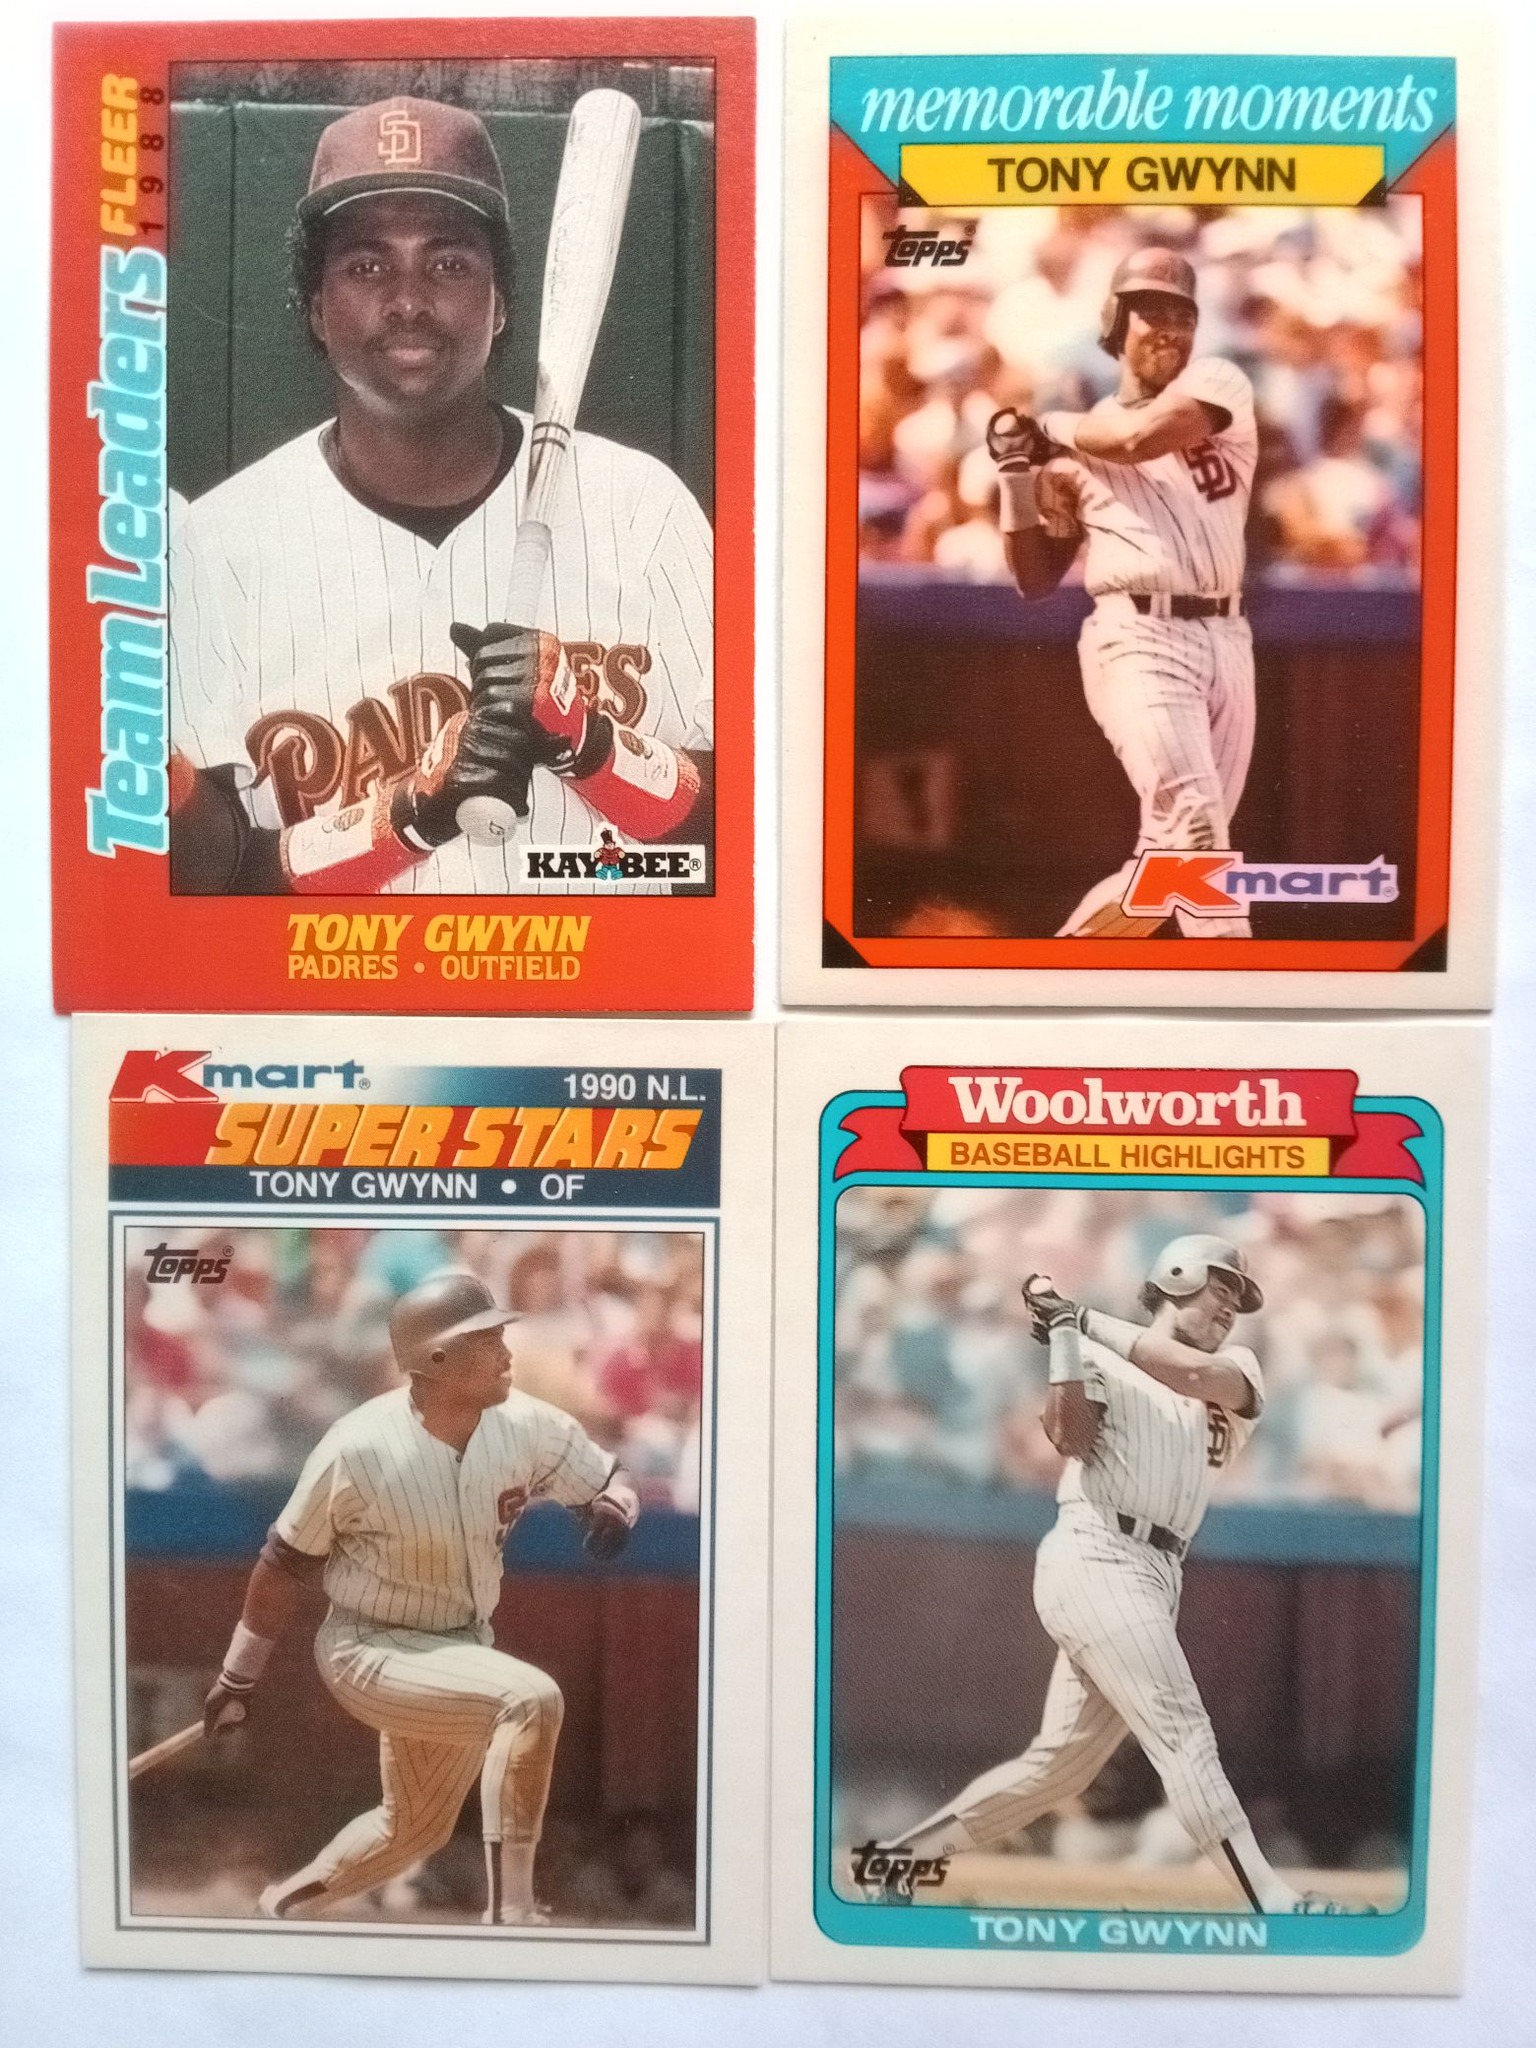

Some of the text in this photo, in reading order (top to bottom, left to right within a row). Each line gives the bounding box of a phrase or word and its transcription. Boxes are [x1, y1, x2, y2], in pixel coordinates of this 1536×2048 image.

[860, 68, 1438, 133] memorable moments
[99, 73, 139, 237] FLEER
[987, 156, 1297, 193] TONY GWYNN
[527, 852, 601, 879] KAY
[287, 913, 592, 953] TONY GWYNN
[287, 954, 581, 981] PADRES OUTFIELD
[563, 1073, 638, 1101] 1990
[646, 1075, 706, 1102] N.L.
[948, 1075, 1307, 1128] Woolworth
[205, 1103, 704, 1170] SUPER STARS
[950, 1142, 1306, 1170] BASEBALL HIGHLIGHTS
[249, 1171, 585, 1201] TONY GWYNN OF
[970, 1915, 1268, 1948] TONY GWYNN
